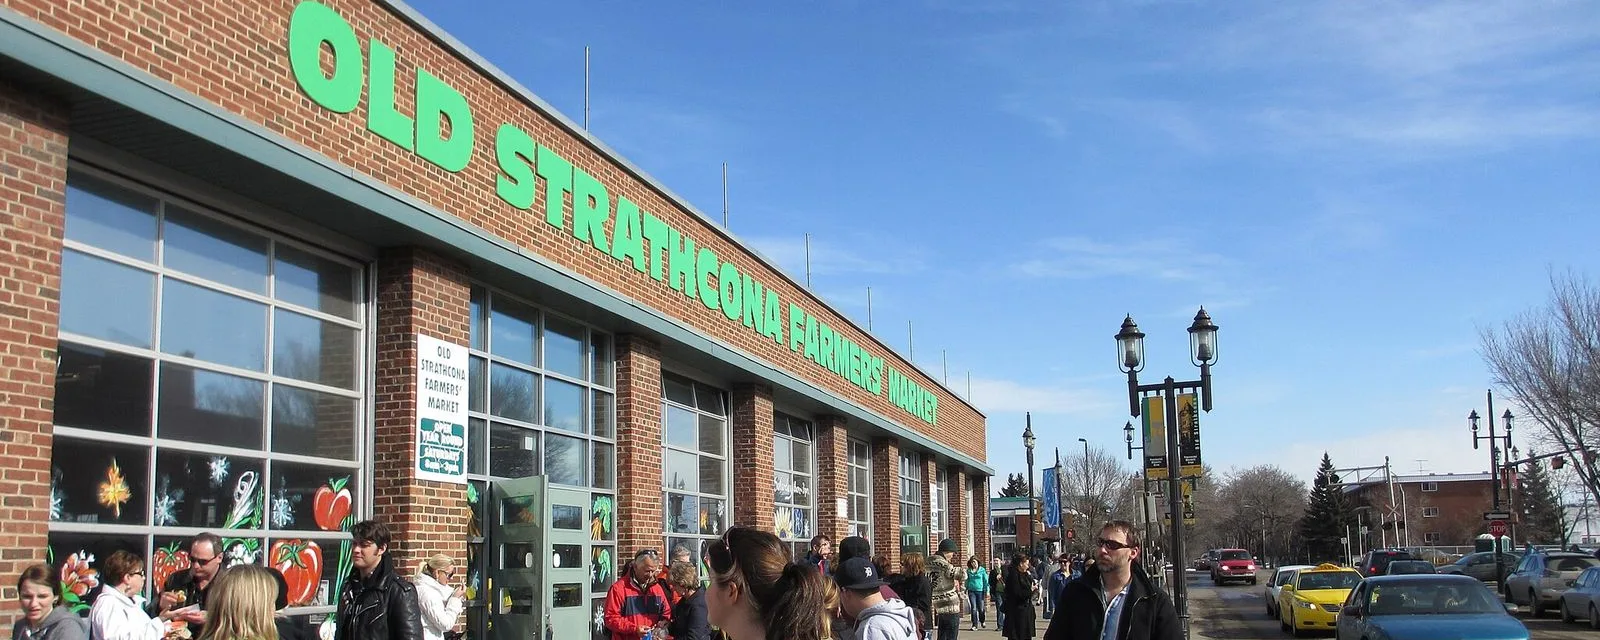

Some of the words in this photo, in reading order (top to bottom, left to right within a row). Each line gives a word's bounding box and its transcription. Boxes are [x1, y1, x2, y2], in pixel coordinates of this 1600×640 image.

[288, 0, 474, 173] OLD
[494, 122, 783, 345] STRATHCONA
[789, 303, 885, 396] FARMERS'
[888, 366, 938, 426] MARKET
[437, 346, 451, 360] OLD
[421, 359, 466, 380] STRATHCONA
[425, 377, 462, 396] FARMERS'
[427, 396, 459, 413] MARKET
[435, 422, 452, 434] OPEN
[422, 431, 439, 442] YEAR
[441, 434, 463, 446] ROUND
[424, 447, 460, 461] SATURDAYS
[1489, 525, 1505, 533] STOP
